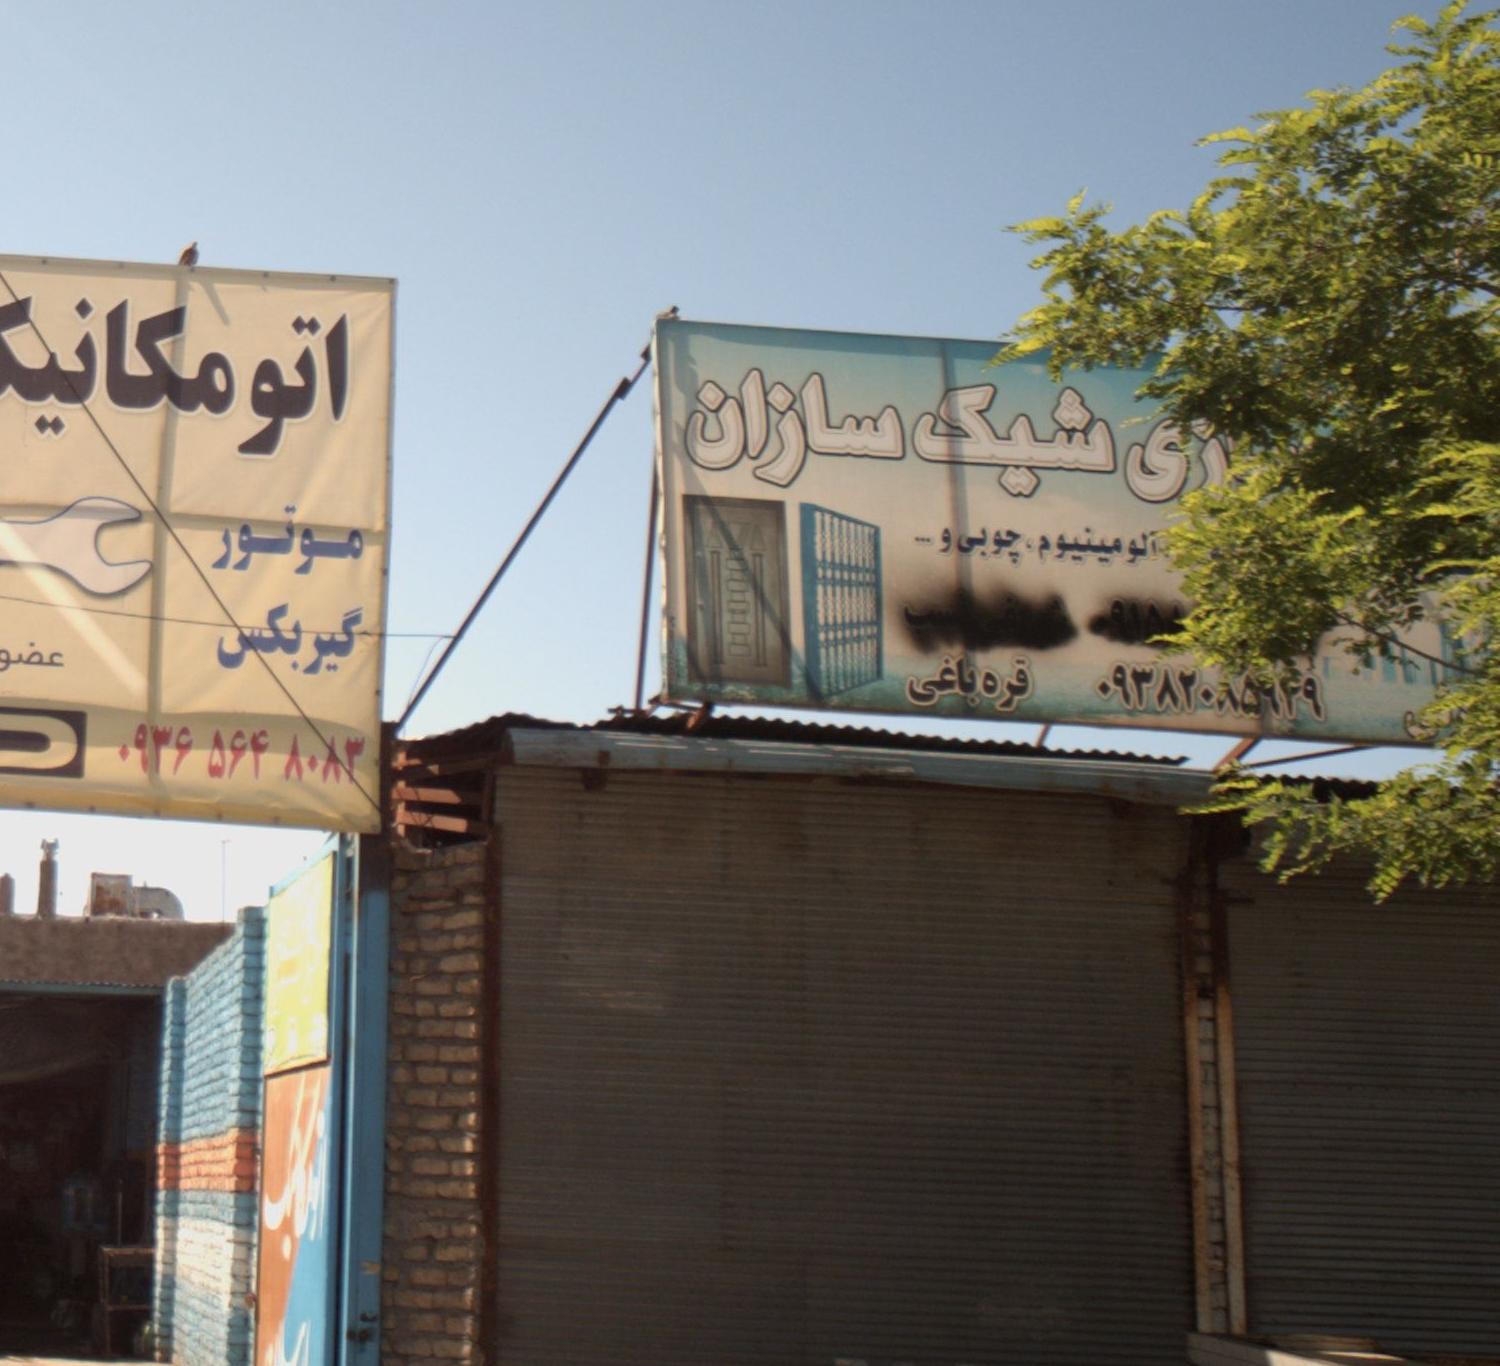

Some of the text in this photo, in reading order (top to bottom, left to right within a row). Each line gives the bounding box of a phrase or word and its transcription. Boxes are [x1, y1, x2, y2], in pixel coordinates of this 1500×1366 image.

[685, 368, 906, 488] سازان
[911, 385, 1117, 497] شیک
[211, 504, 364, 575] موتور
[941, 527, 952, 553] و
[957, 526, 1022, 566] چوبی
[216, 602, 364, 675] گیربکس
[118, 722, 194, 777] ۰۹۳۶
[207, 728, 271, 781] ۵۶۴
[283, 732, 367, 786] ۸۰۸۳
